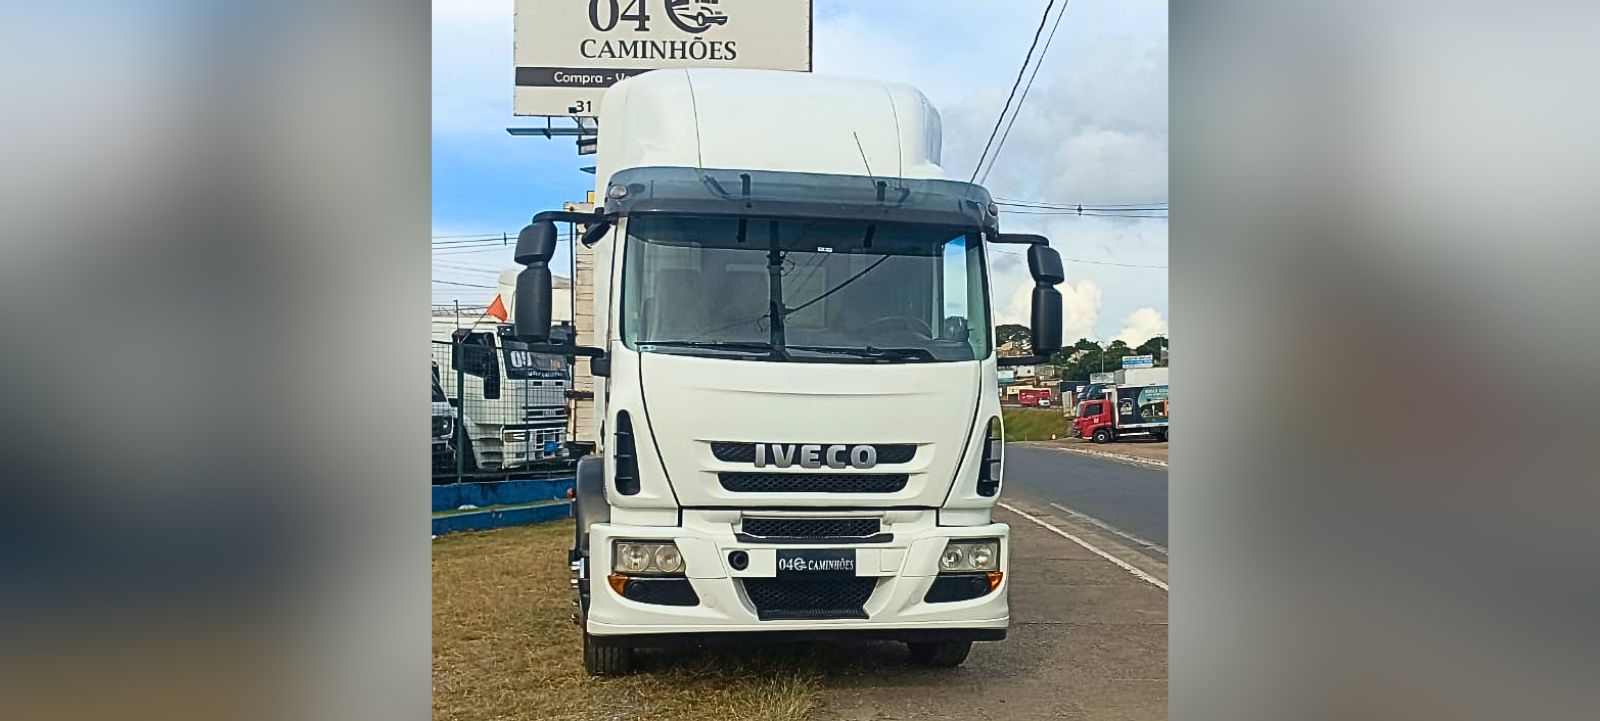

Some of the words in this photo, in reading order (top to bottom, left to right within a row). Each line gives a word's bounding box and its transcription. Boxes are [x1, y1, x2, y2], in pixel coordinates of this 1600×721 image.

[588, 0, 651, 32] 04
[580, 36, 737, 61] CAMINHÕES
[554, 71, 603, 84] Compra
[575, 100, 592, 113] 31
[754, 443, 878, 469] IVECO
[778, 558, 794, 571] 04
